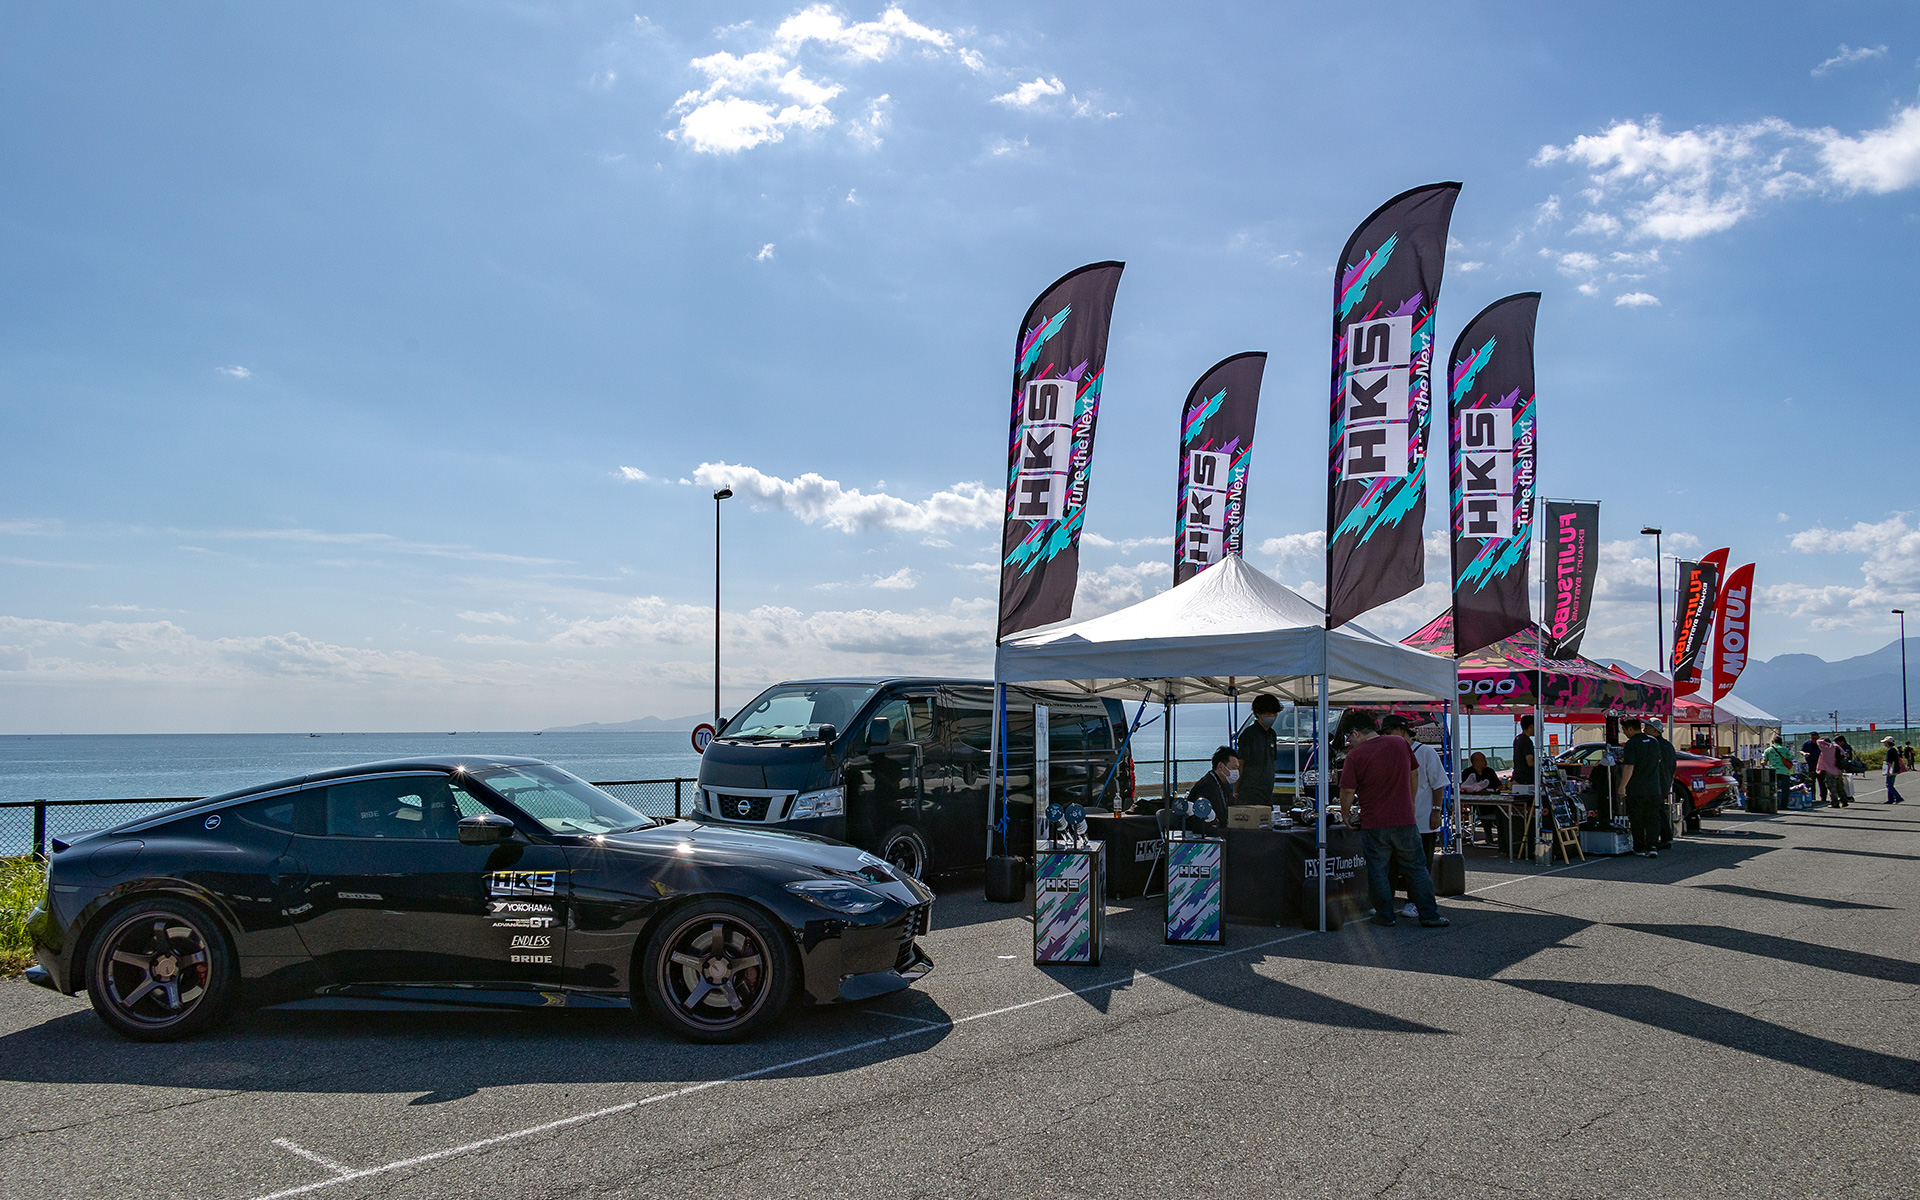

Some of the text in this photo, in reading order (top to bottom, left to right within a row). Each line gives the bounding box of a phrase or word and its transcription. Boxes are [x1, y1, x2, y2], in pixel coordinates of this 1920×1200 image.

[1415, 331, 1431, 378] Next
[1347, 321, 1394, 476] HKS
[1414, 379, 1429, 411] the
[1018, 382, 1062, 519] HKS
[1067, 396, 1095, 510] Tune the Next
[1465, 411, 1501, 534] HKS
[1517, 419, 1533, 528] Tune the Next
[1189, 453, 1219, 563] HKS
[1226, 467, 1245, 556] Tune the Next
[1722, 585, 1747, 676] MOTUL
[697, 732, 712, 746] 70
[1136, 840, 1165, 857] HKS
[1179, 866, 1210, 876] HKS
[1305, 858, 1336, 877] HS
[1336, 856, 1353, 870] Tune
[1353, 854, 1364, 868] the
[492, 872, 554, 890] HKS
[1046, 879, 1079, 890] HKS
[507, 903, 553, 912] YOKOHAMA
[529, 917, 554, 928] GT
[511, 935, 551, 946] ENDLESS
[510, 955, 552, 964] BRIDE
